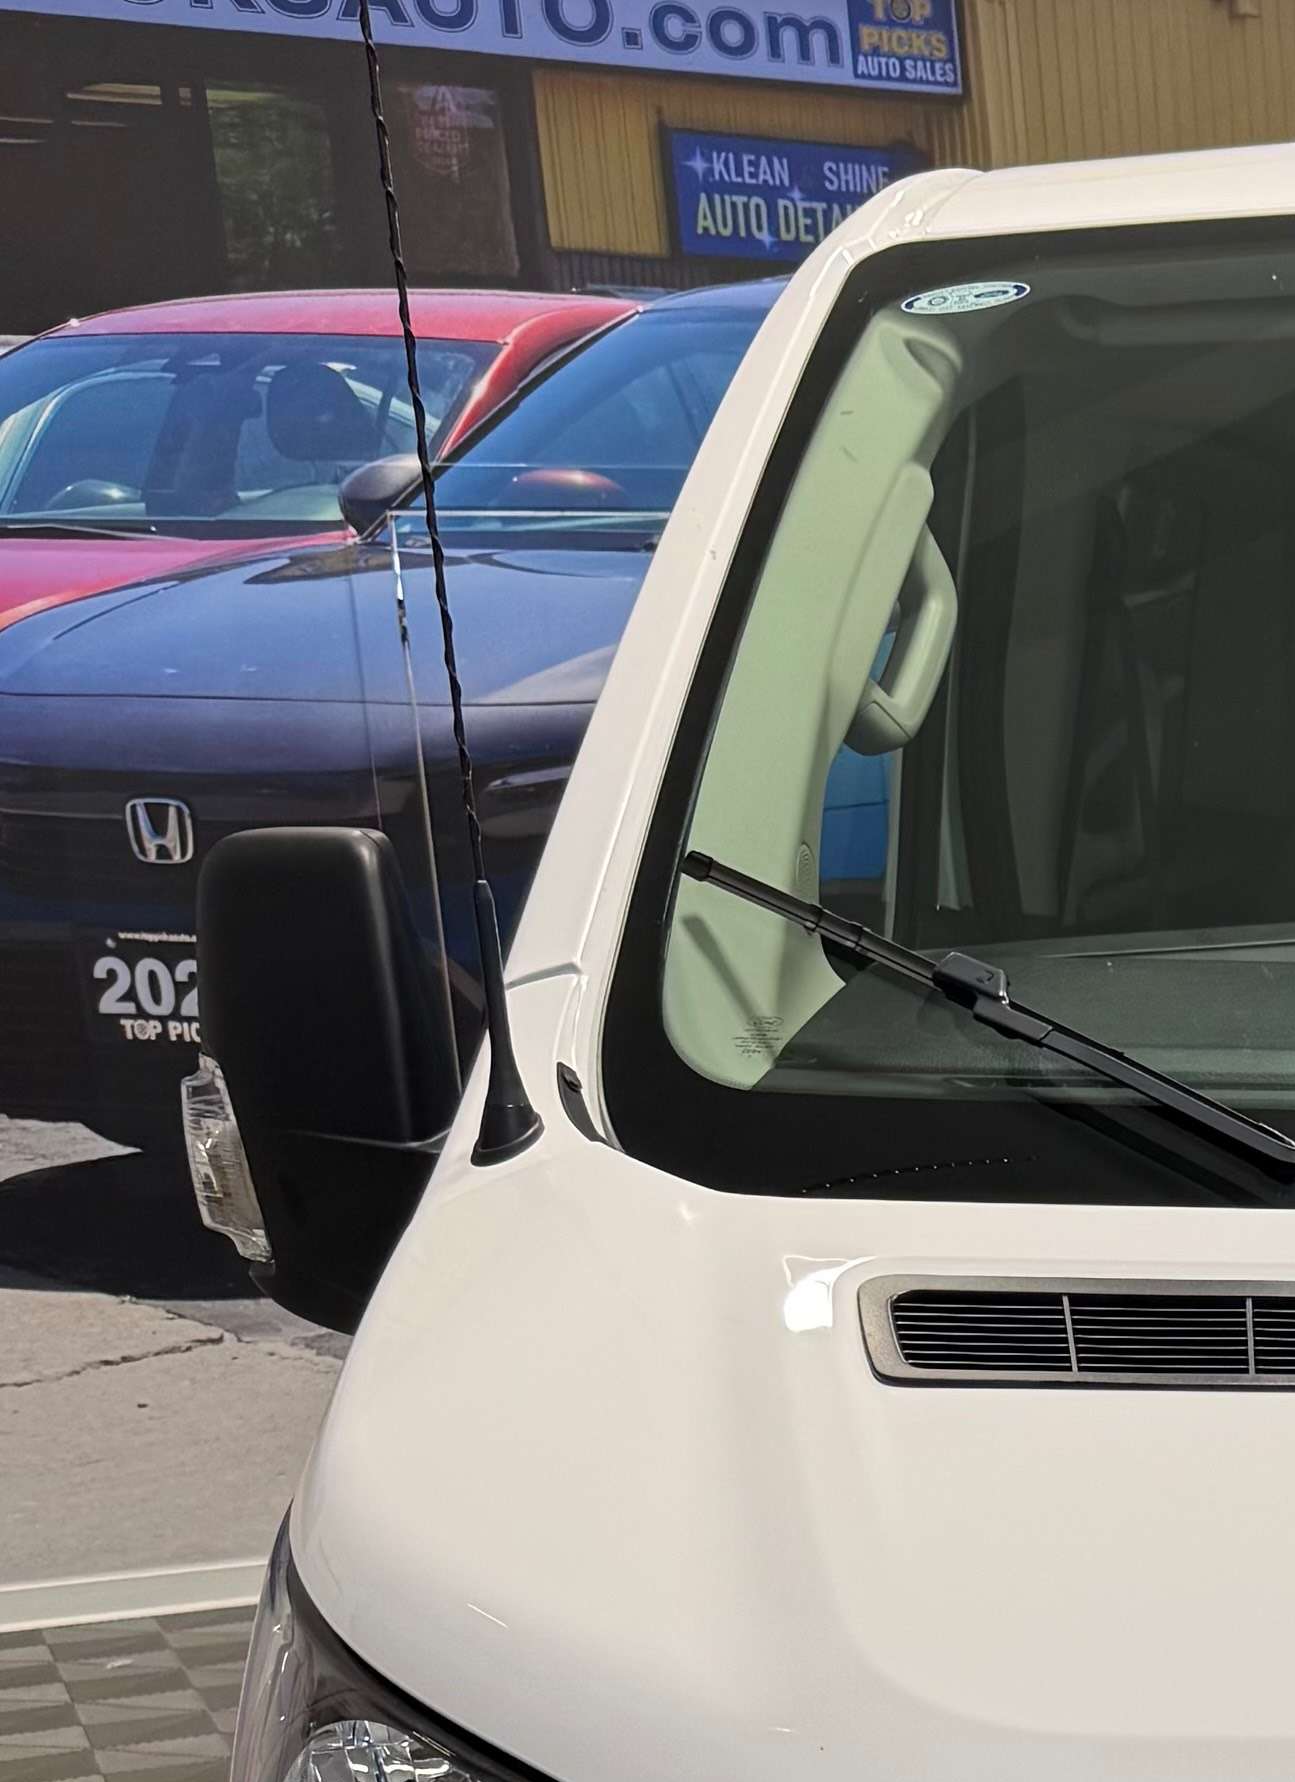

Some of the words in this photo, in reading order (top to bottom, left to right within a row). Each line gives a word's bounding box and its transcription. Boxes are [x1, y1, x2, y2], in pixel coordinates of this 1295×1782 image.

[858, 26, 947, 58] PICKS
[856, 55, 900, 79] AUTO
[904, 59, 955, 84] SALES
[712, 151, 790, 188] KLEAN
[697, 192, 770, 240] AUTO
[93, 956, 199, 1017] 202
[120, 1018, 162, 1040] TOP
[167, 1020, 201, 1043] PIC
